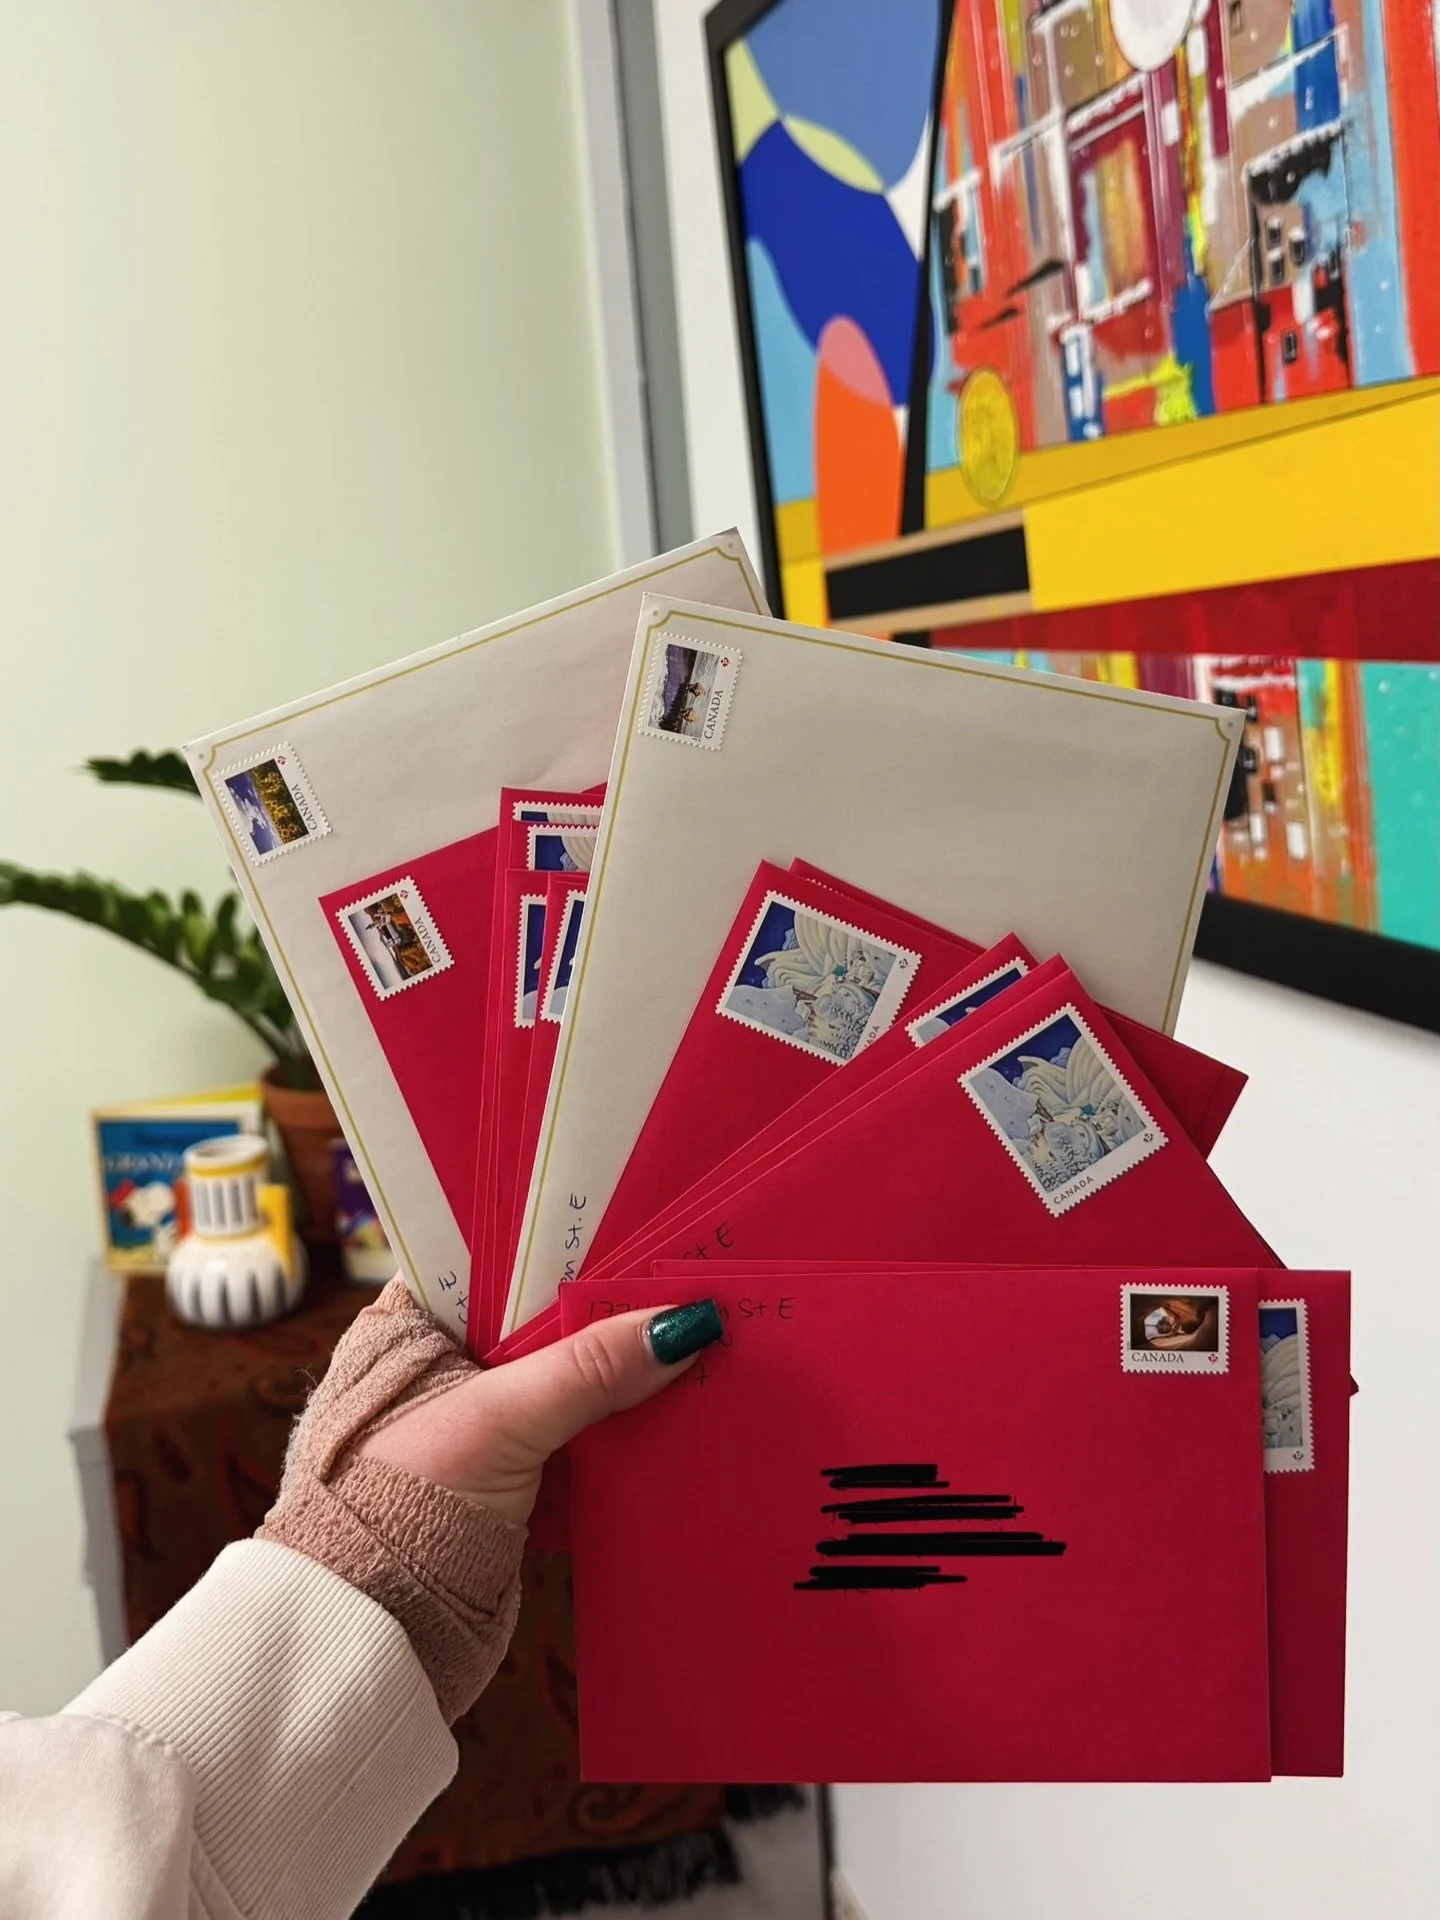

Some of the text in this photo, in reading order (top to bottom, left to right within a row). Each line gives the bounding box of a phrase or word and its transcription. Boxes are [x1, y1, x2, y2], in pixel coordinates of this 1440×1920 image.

[703, 689, 723, 740] CANADA
[291, 783, 318, 830] CANADA
[414, 916, 441, 963] CANADA
[569, 1193, 587, 1210] E
[1052, 1175, 1095, 1205] CANADA
[778, 1297, 797, 1320] E
[1131, 1351, 1185, 1364] CANADA
